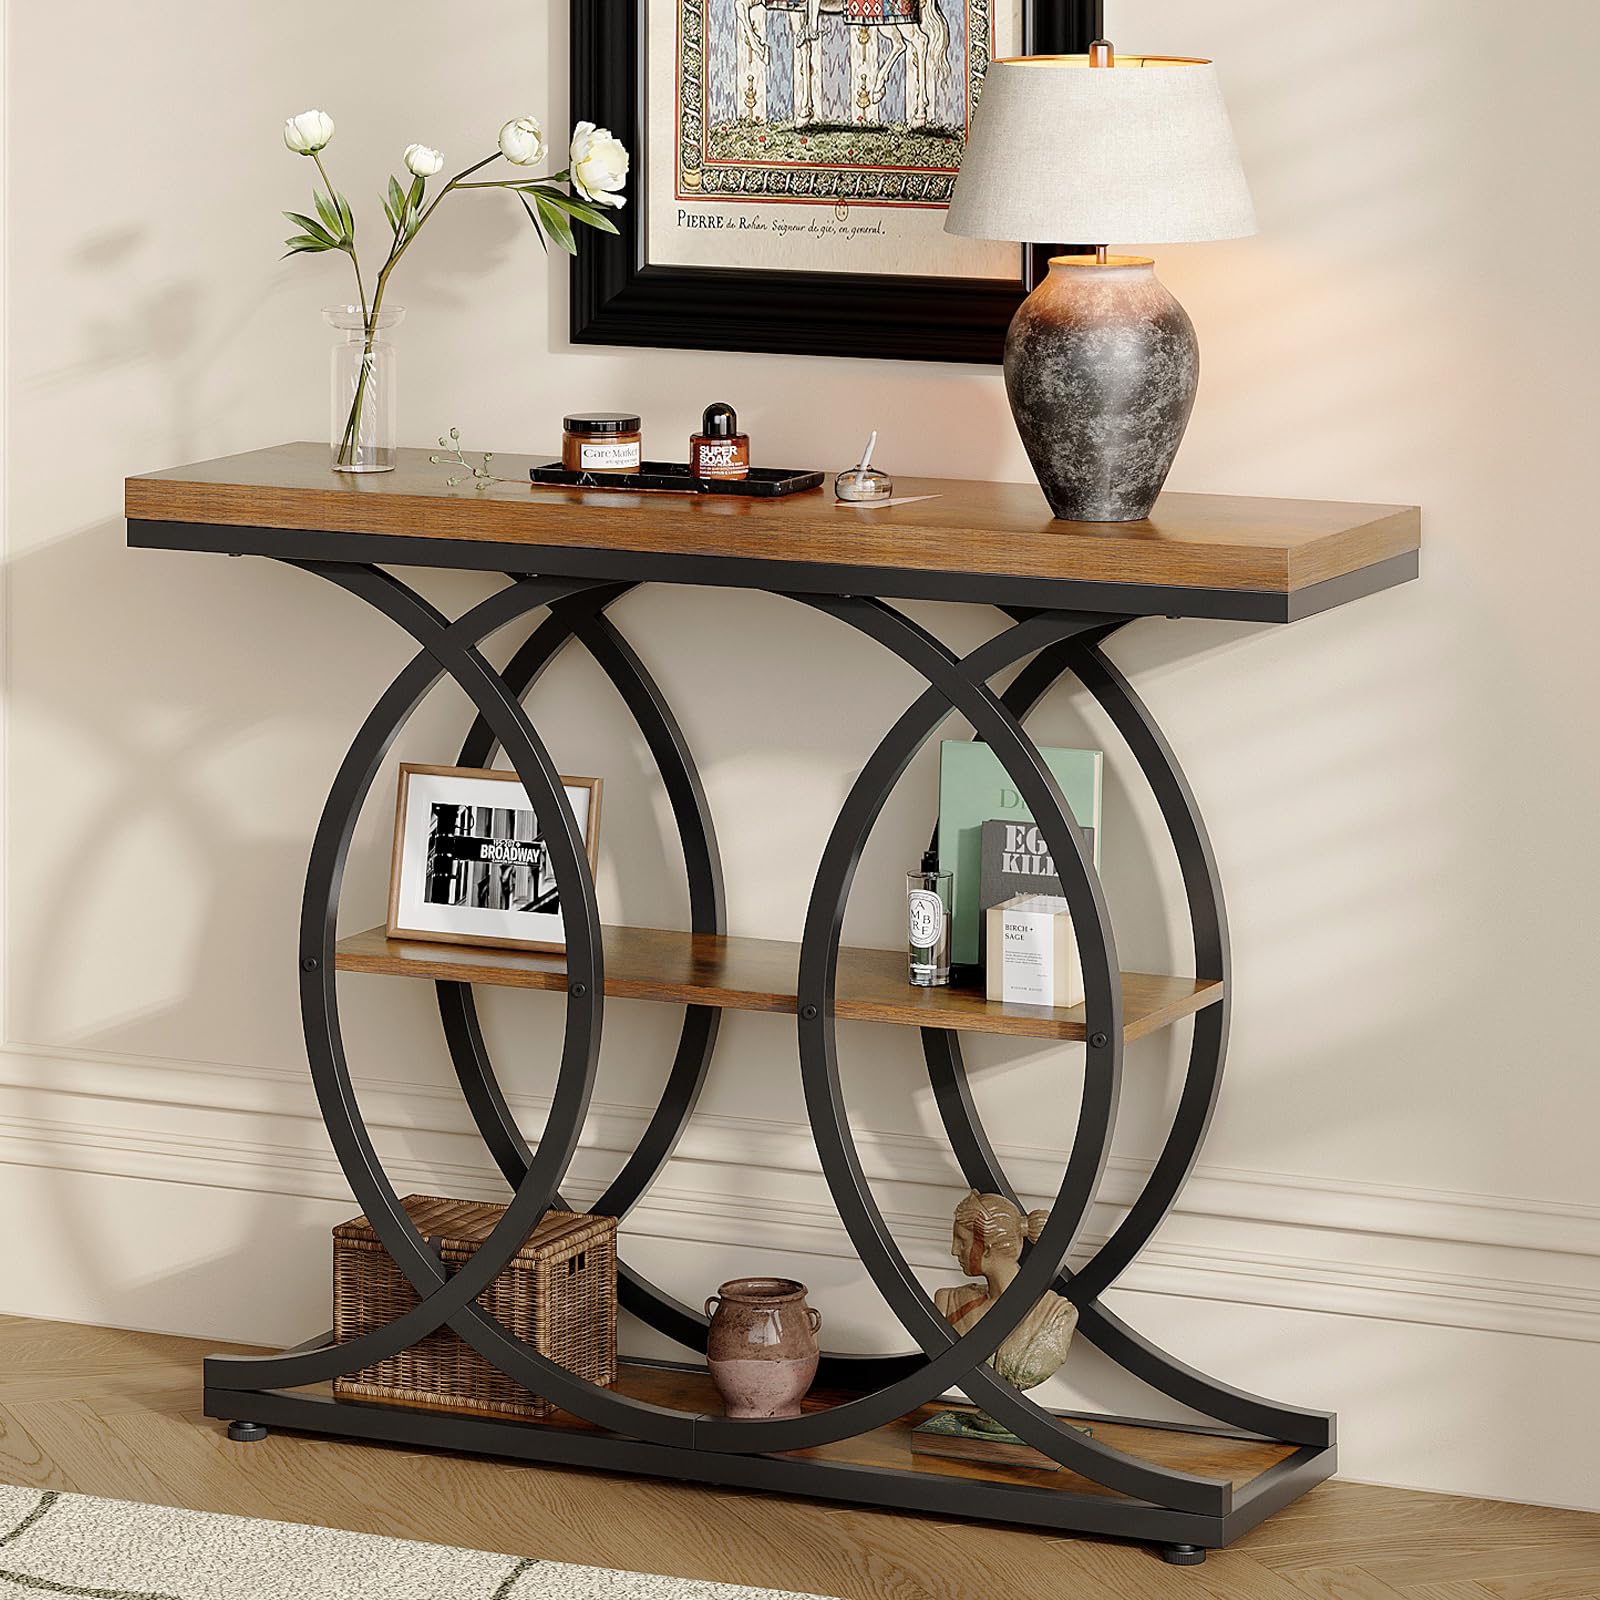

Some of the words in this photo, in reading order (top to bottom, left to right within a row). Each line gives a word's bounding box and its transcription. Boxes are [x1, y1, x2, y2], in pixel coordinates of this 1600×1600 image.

[677, 209, 724, 229] PIERRE
[739, 215, 768, 230] Rohan
[583, 448, 611, 458] Care
[699, 445, 738, 456] SUPER
[699, 455, 732, 465] SOAK
[1000, 789, 1026, 809] D
[480, 844, 540, 863] BROADWAY
[1005, 924, 1028, 932] BIRCH
